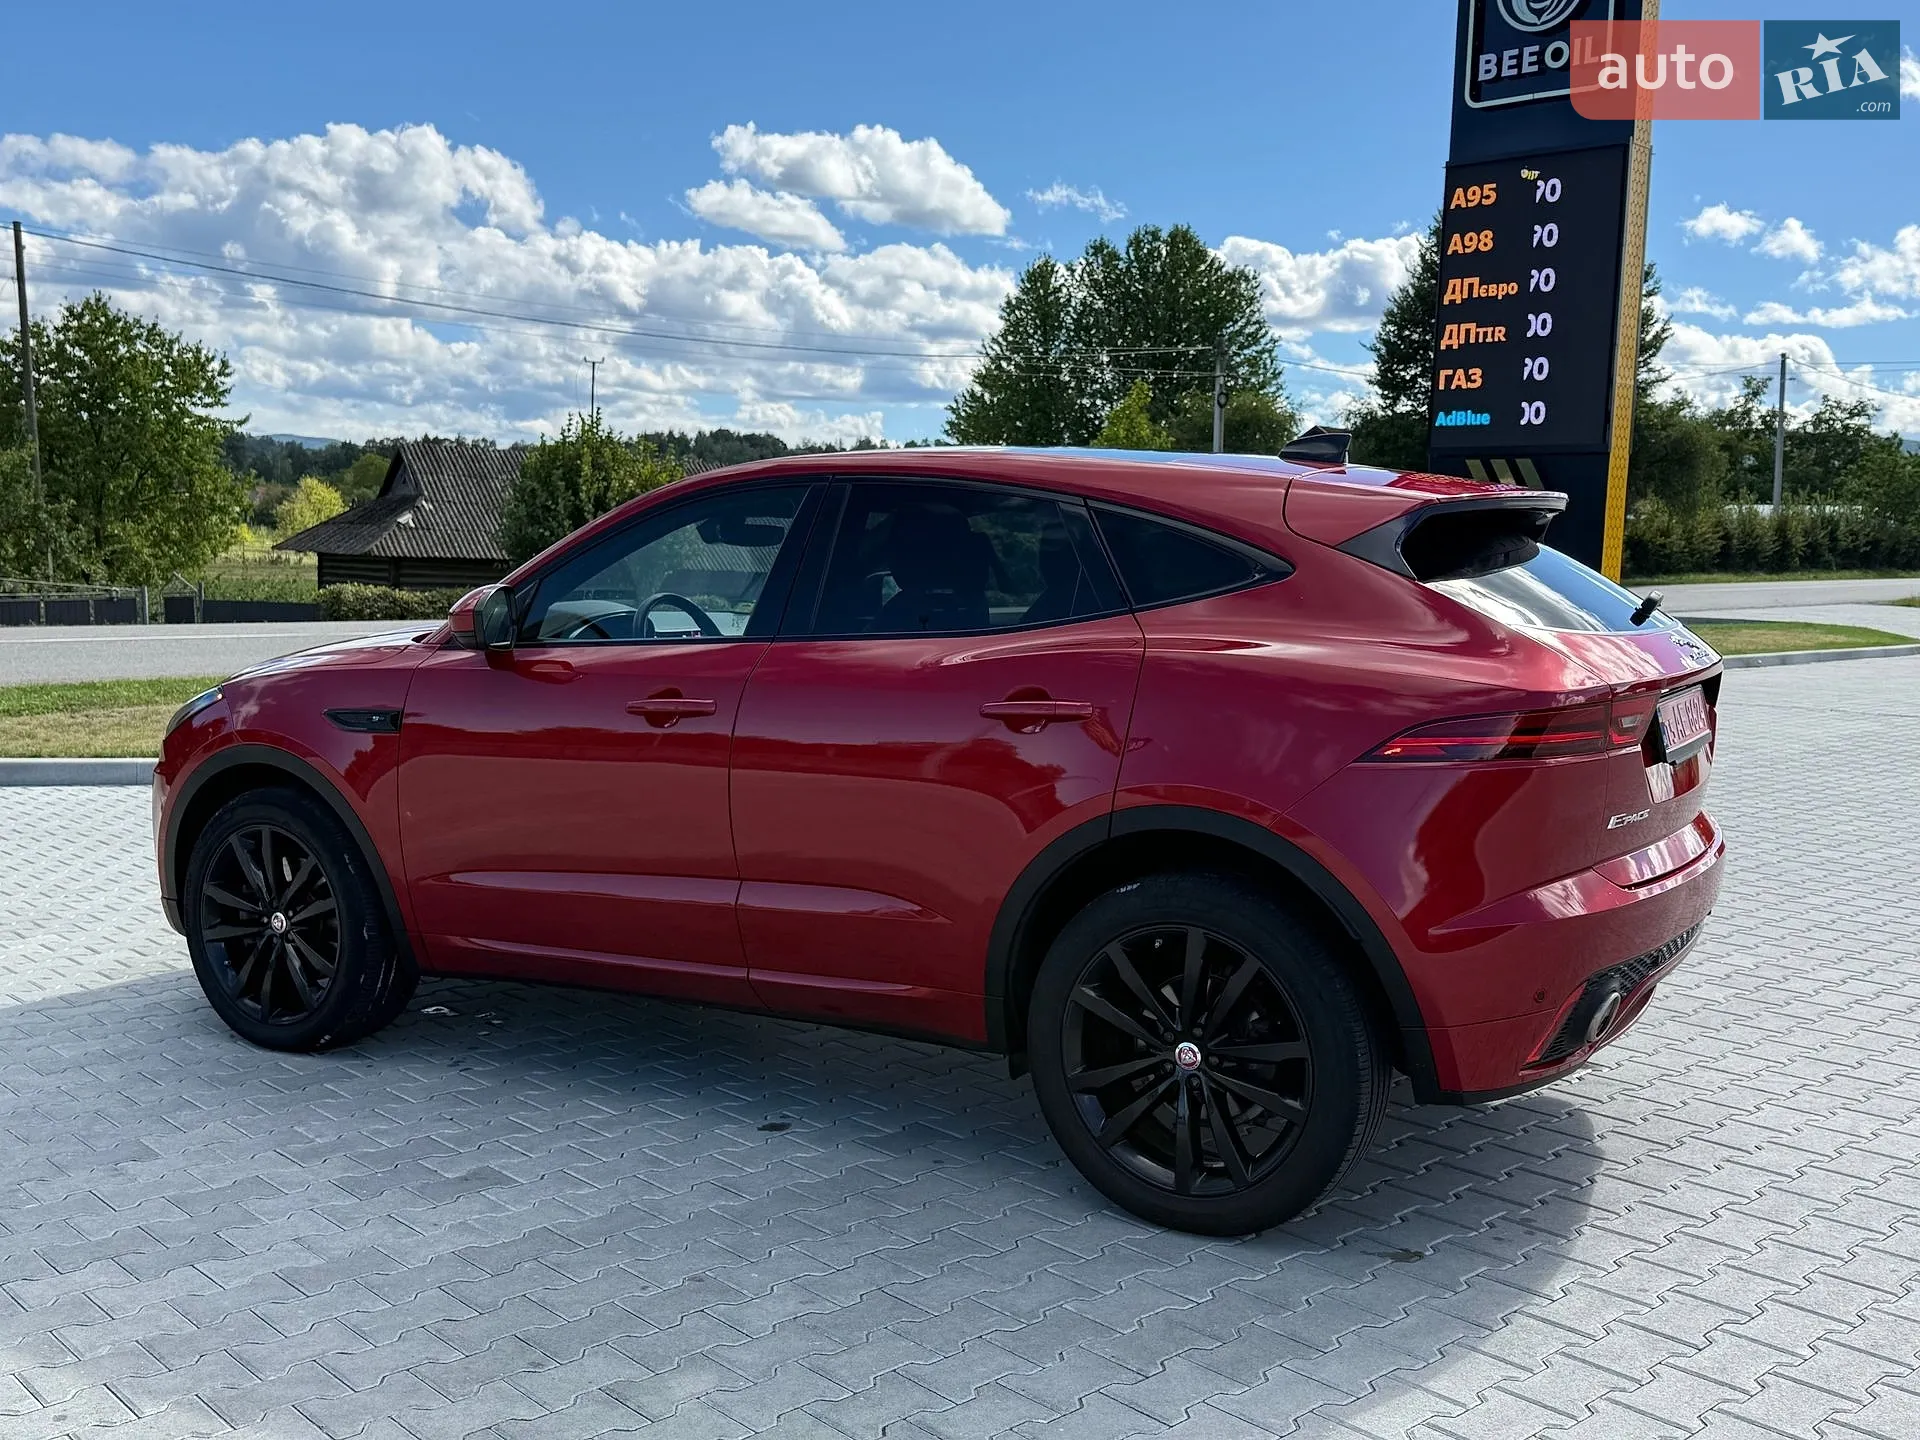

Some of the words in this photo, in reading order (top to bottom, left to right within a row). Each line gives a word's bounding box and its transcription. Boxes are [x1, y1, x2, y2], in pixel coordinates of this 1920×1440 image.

[1478, 45, 1540, 81] BEE
[1438, 368, 1483, 390] ГАЗ
[1435, 410, 1491, 427] AdBlue
